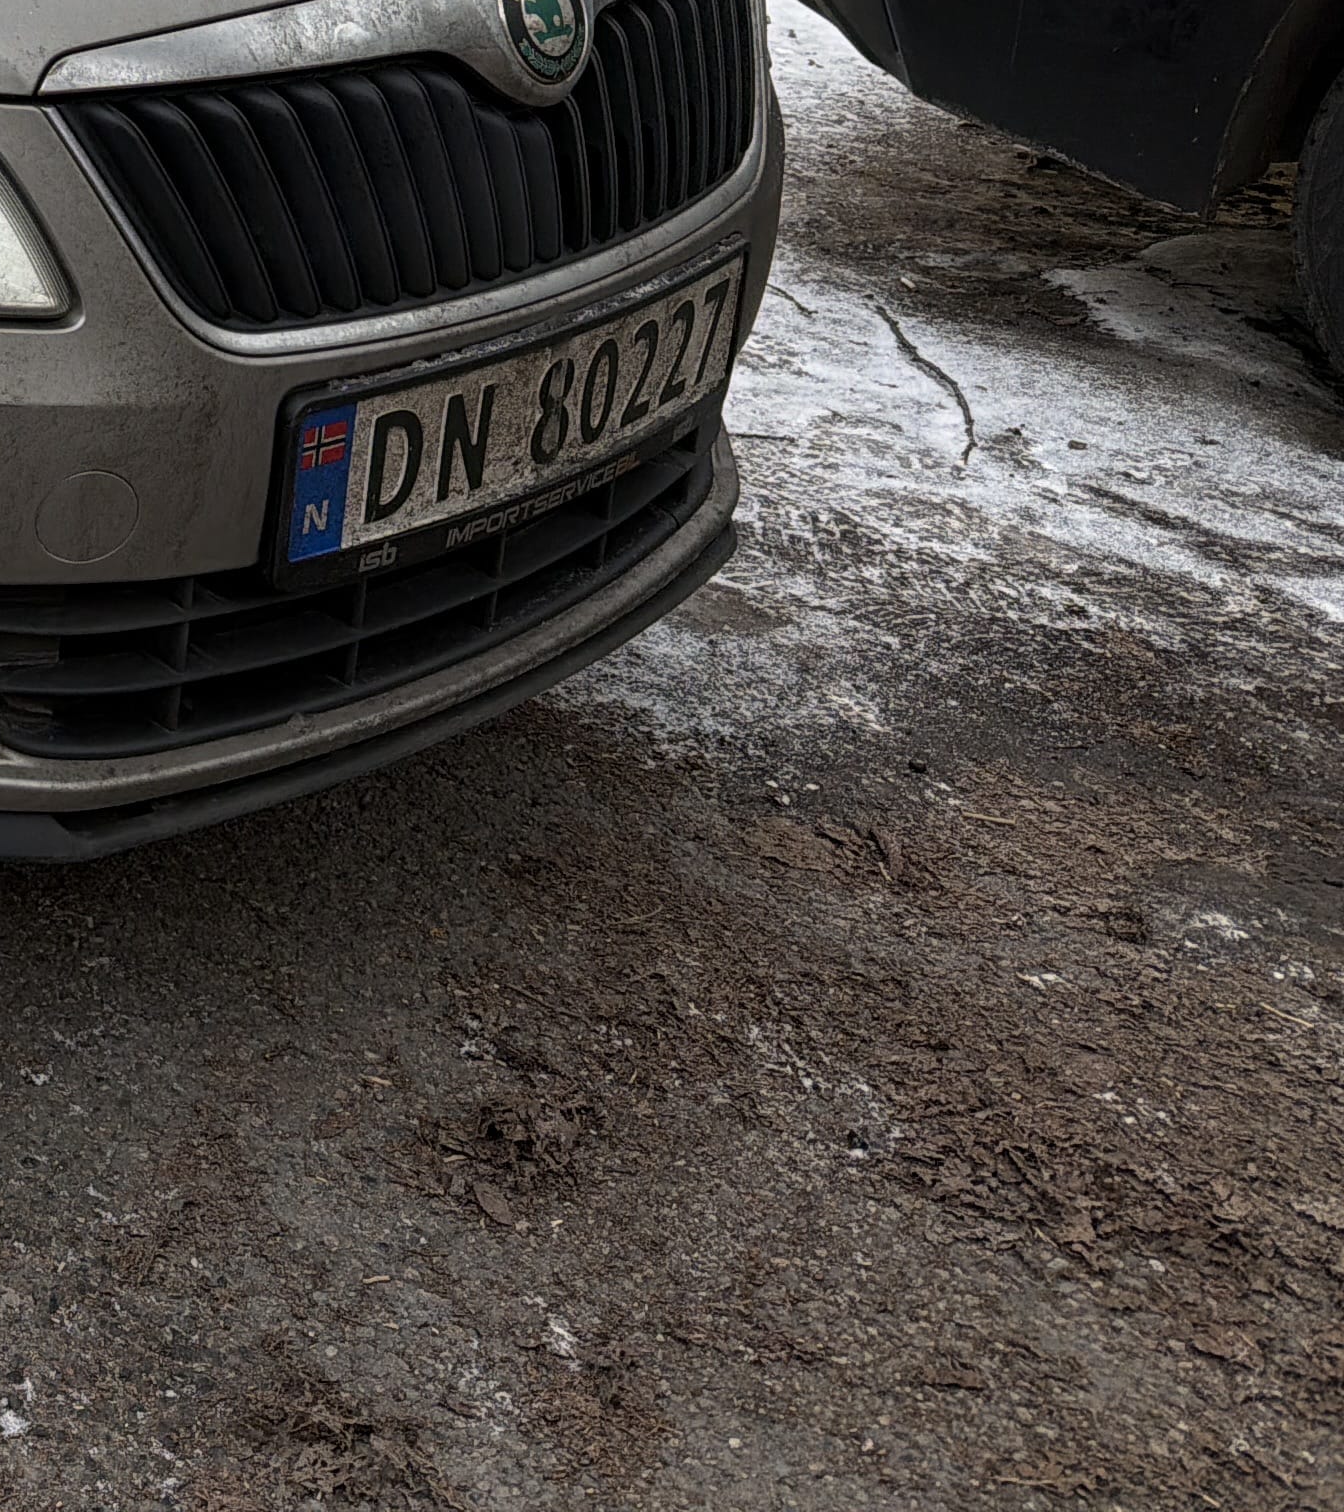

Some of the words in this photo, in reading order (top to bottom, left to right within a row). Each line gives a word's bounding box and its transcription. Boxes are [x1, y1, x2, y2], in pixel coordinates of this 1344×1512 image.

[300, 500, 330, 536] N
[363, 384, 497, 525] DN
[528, 276, 731, 466] 80227
